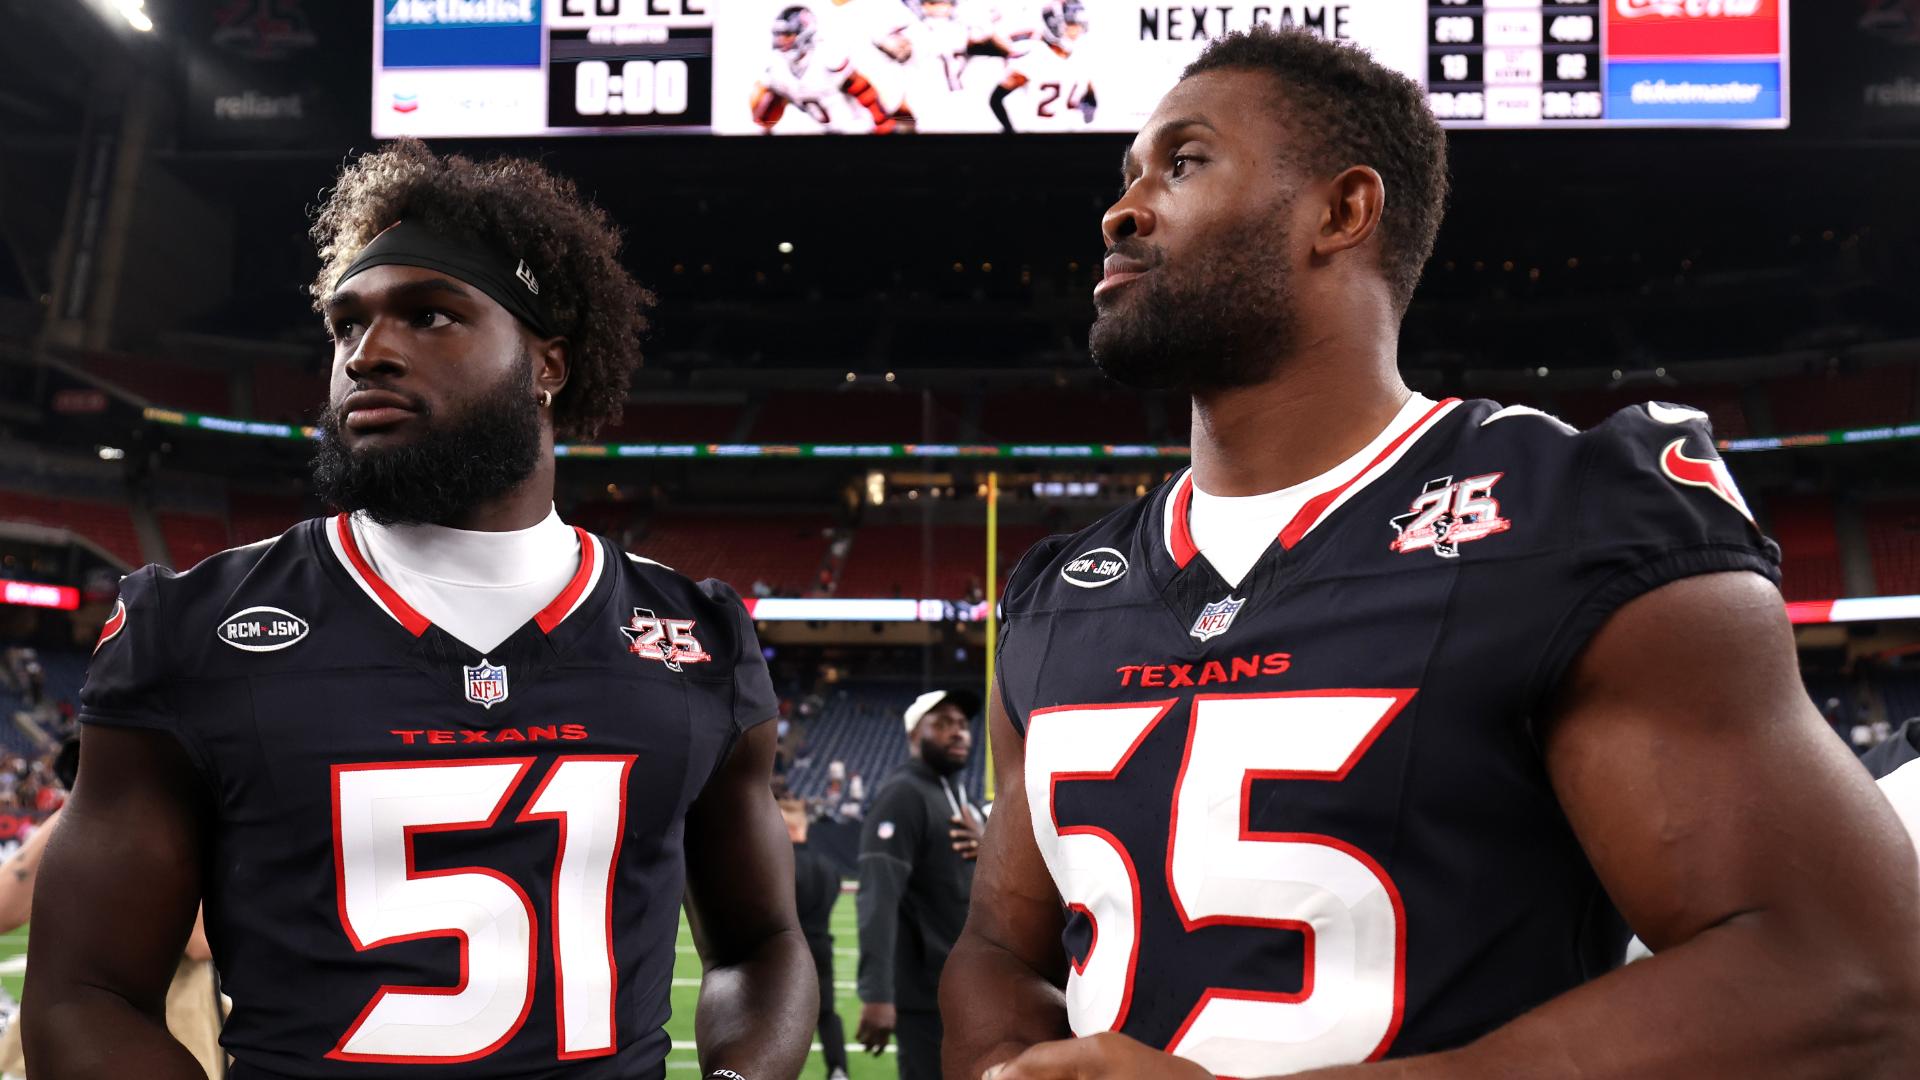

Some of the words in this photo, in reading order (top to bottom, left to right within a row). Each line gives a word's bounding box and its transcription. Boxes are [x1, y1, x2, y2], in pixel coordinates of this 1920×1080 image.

[1140, 7, 1233, 40] NEXT
[575, 60, 688, 115] 0:00
[1631, 79, 1762, 104] ticketmaster
[214, 90, 302, 120] reliant
[1402, 472, 1504, 552] 25
[1093, 560, 1122, 577] JSM
[226, 621, 261, 639] RCM
[268, 620, 300, 636] JSM
[1199, 613, 1227, 633] NFL
[630, 616, 705, 662] 25
[1116, 652, 1292, 689] TEXANS
[472, 680, 502, 700] NFL
[389, 723, 589, 745] TEXANS
[1024, 688, 1419, 1080] 55
[323, 754, 639, 1065] 51
